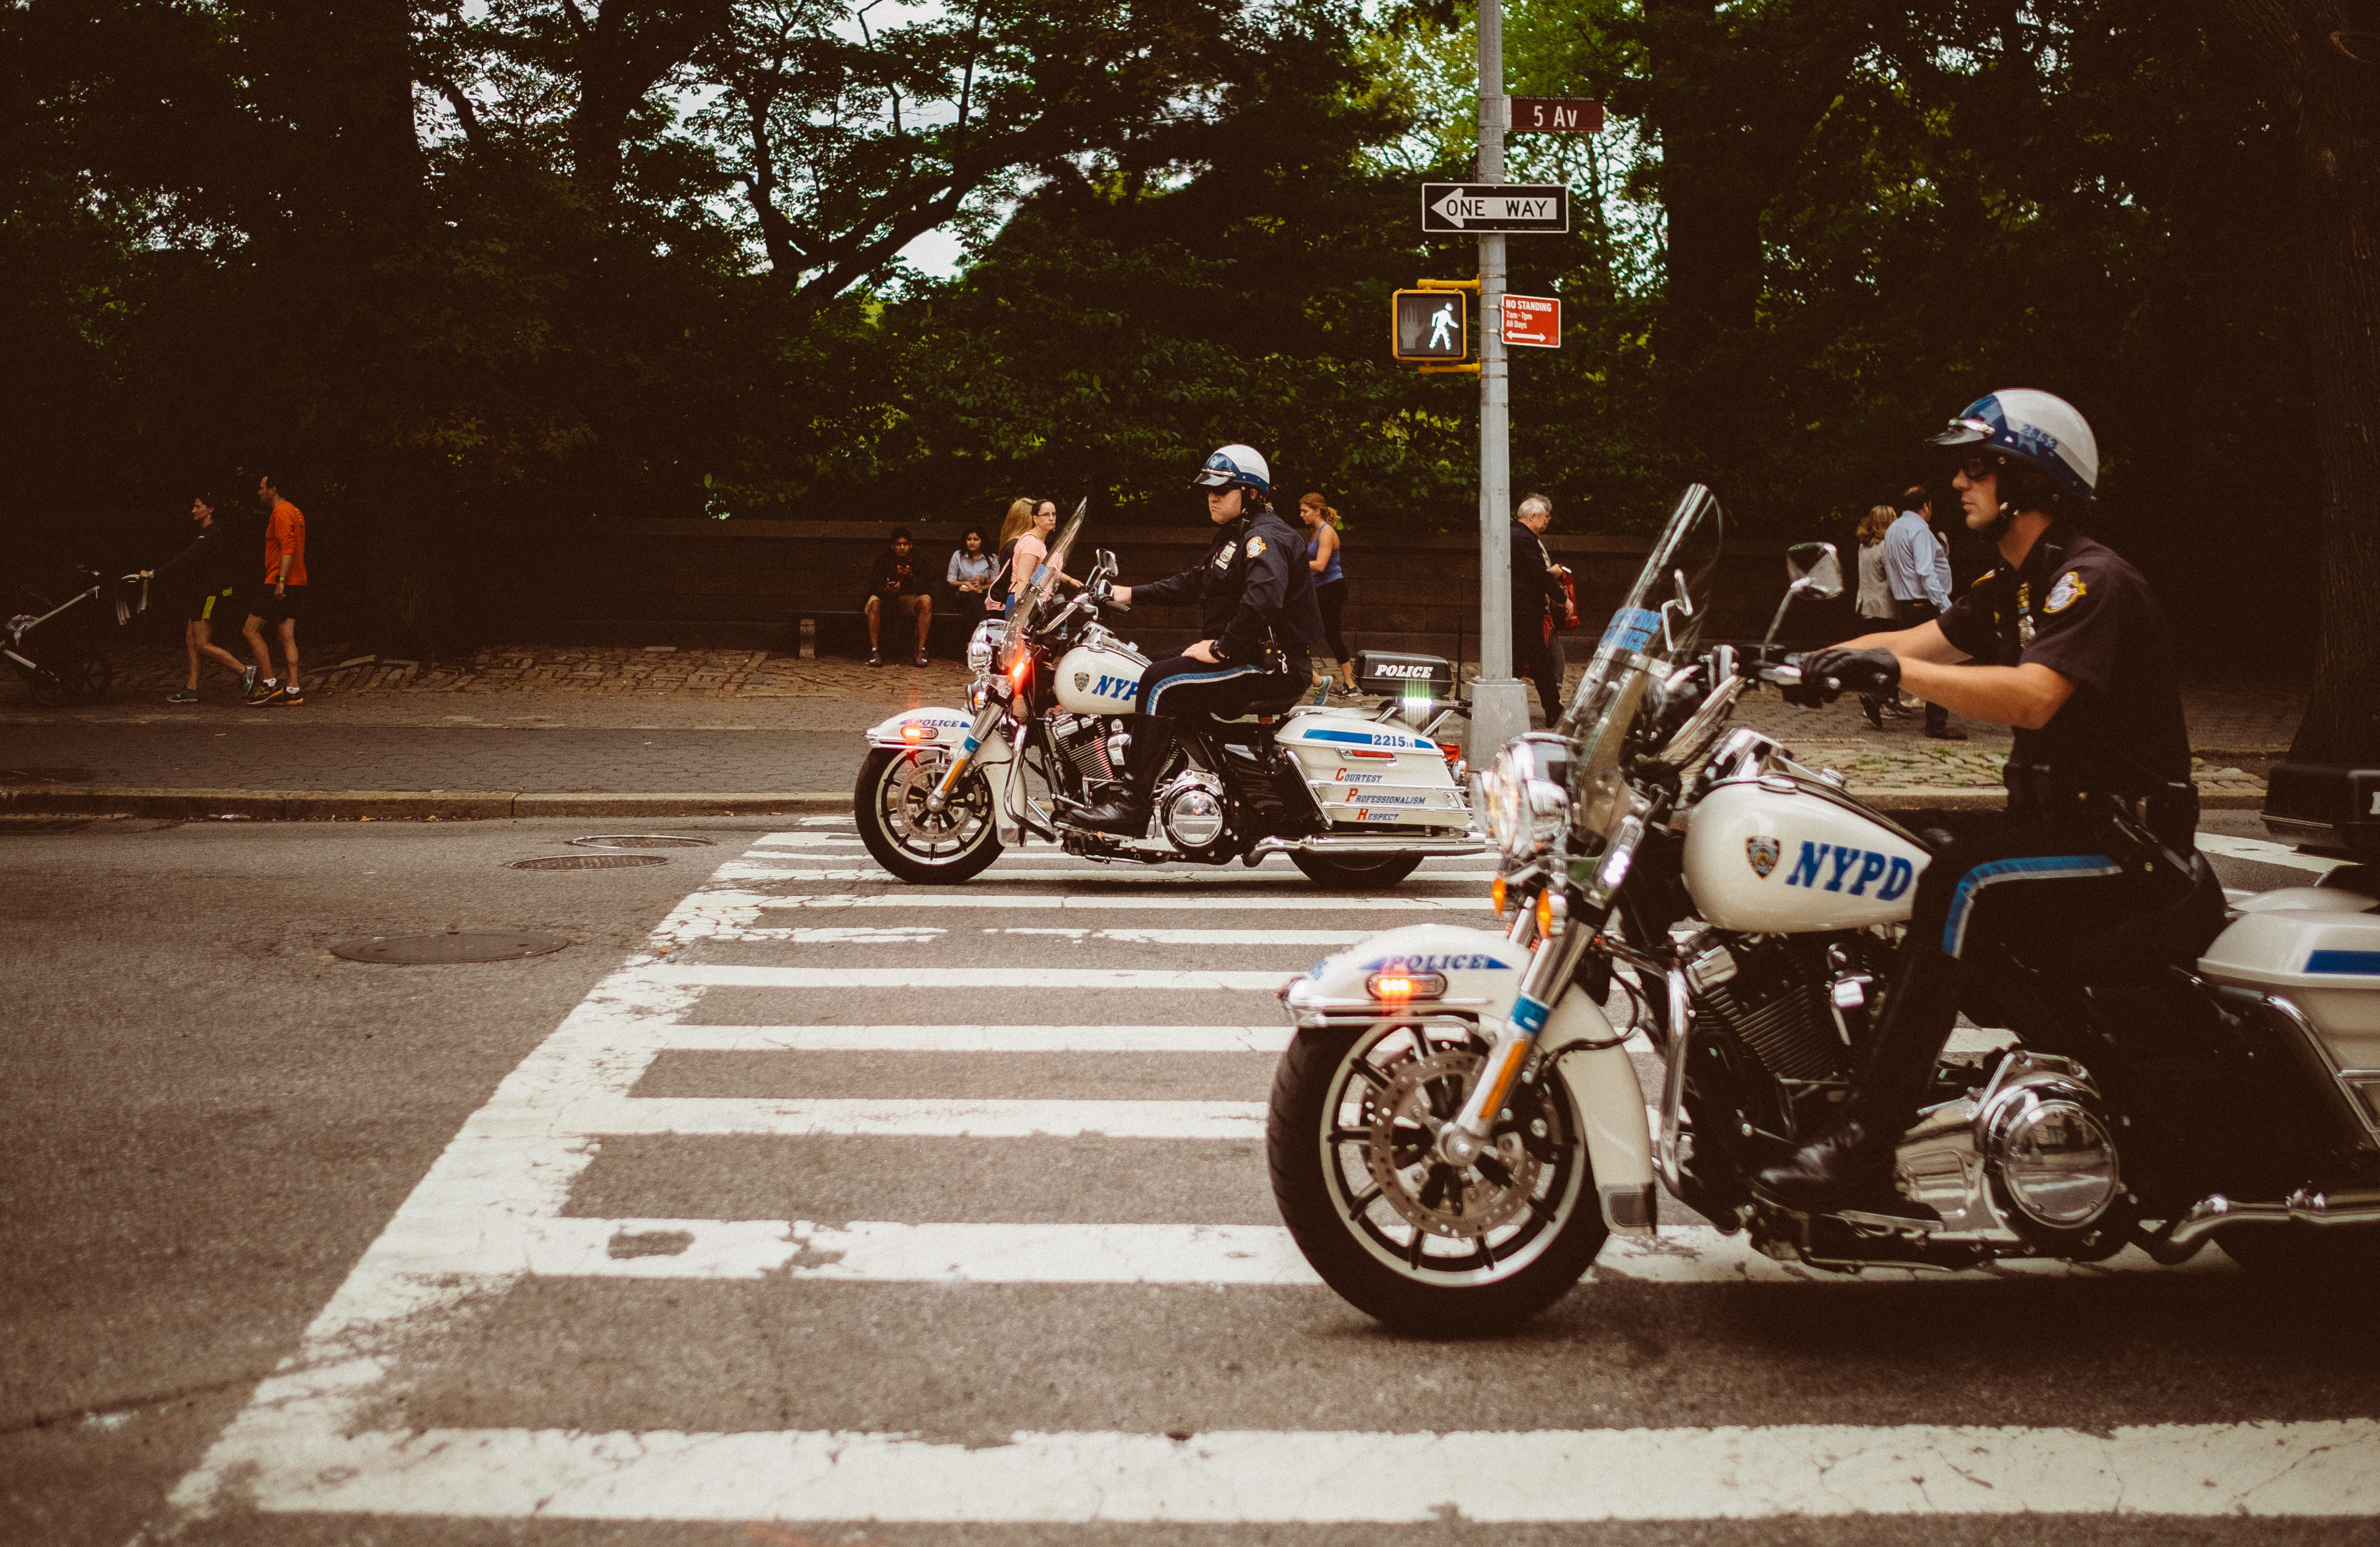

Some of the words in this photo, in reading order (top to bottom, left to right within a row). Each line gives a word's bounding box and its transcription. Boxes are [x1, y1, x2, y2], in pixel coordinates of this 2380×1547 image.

[1534, 105, 1543, 127] 5
[1553, 105, 1577, 127] Av
[1446, 199, 1485, 216] ONE
[1505, 200, 1547, 217] WAY
[1505, 299, 1516, 309] NO
[1517, 300, 1552, 312] STANDING
[1514, 320, 1527, 330] Days
[1375, 664, 1433, 678] POLICE
[1091, 675, 1138, 701] NYP
[916, 719, 959, 727] POLICE
[1374, 734, 1405, 747] 2215
[1335, 768, 1382, 782] COURTESY
[1346, 788, 1426, 804] PROFESSIONALISM
[1356, 809, 1399, 821] RESPECT
[1784, 841, 1913, 901] NYPD
[1385, 953, 1486, 970] POLICE
